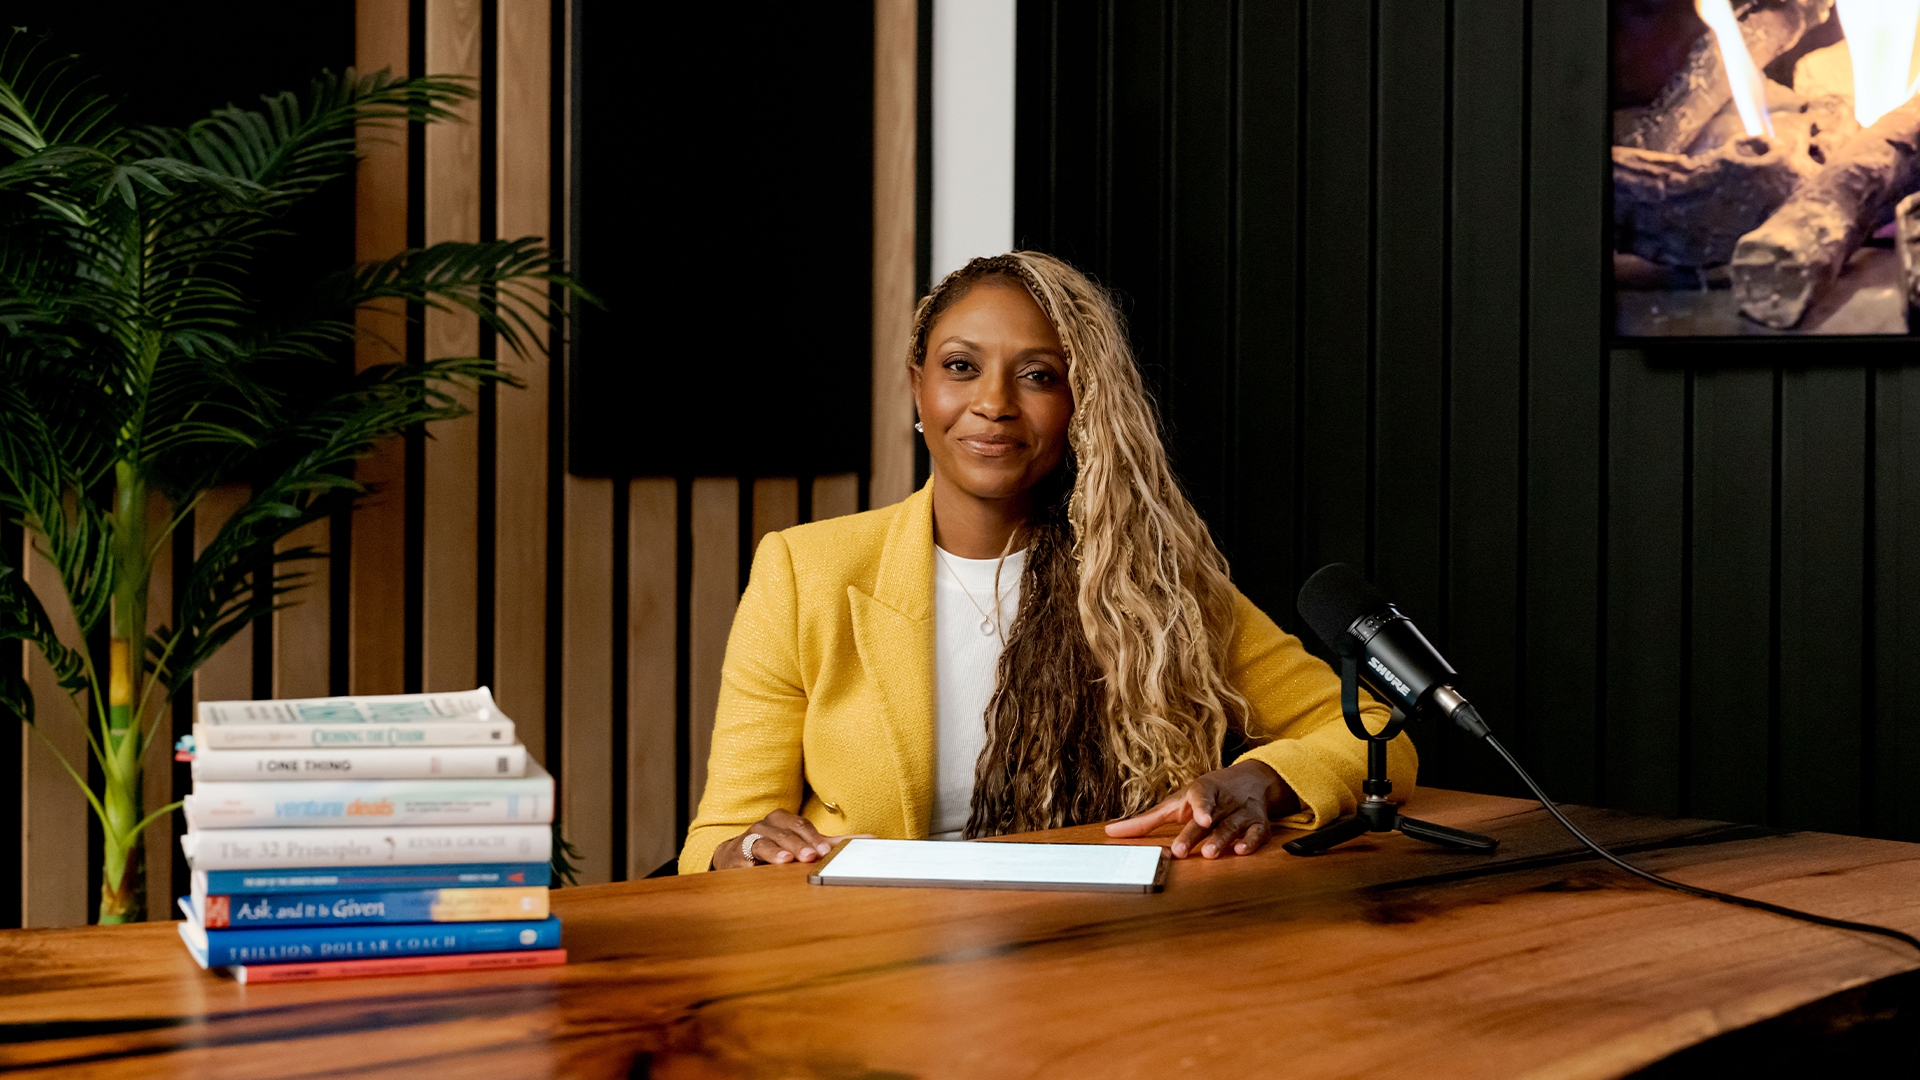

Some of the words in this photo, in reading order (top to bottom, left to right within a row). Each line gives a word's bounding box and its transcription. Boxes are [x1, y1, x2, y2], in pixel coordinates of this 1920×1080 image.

[1367, 656, 1411, 697] SHURE
[266, 760, 299, 772] ONE
[304, 760, 351, 772] THING
[274, 800, 345, 817] venture
[346, 798, 395, 816] deals
[219, 842, 251, 859] The
[256, 841, 281, 859] 32
[286, 840, 372, 861] Principles
[237, 898, 273, 919] Ask
[275, 902, 304, 919] and
[332, 898, 386, 919] Given
[229, 943, 313, 961] TRILLION
[320, 939, 389, 956] DOLLAR
[395, 935, 456, 950] COACH
